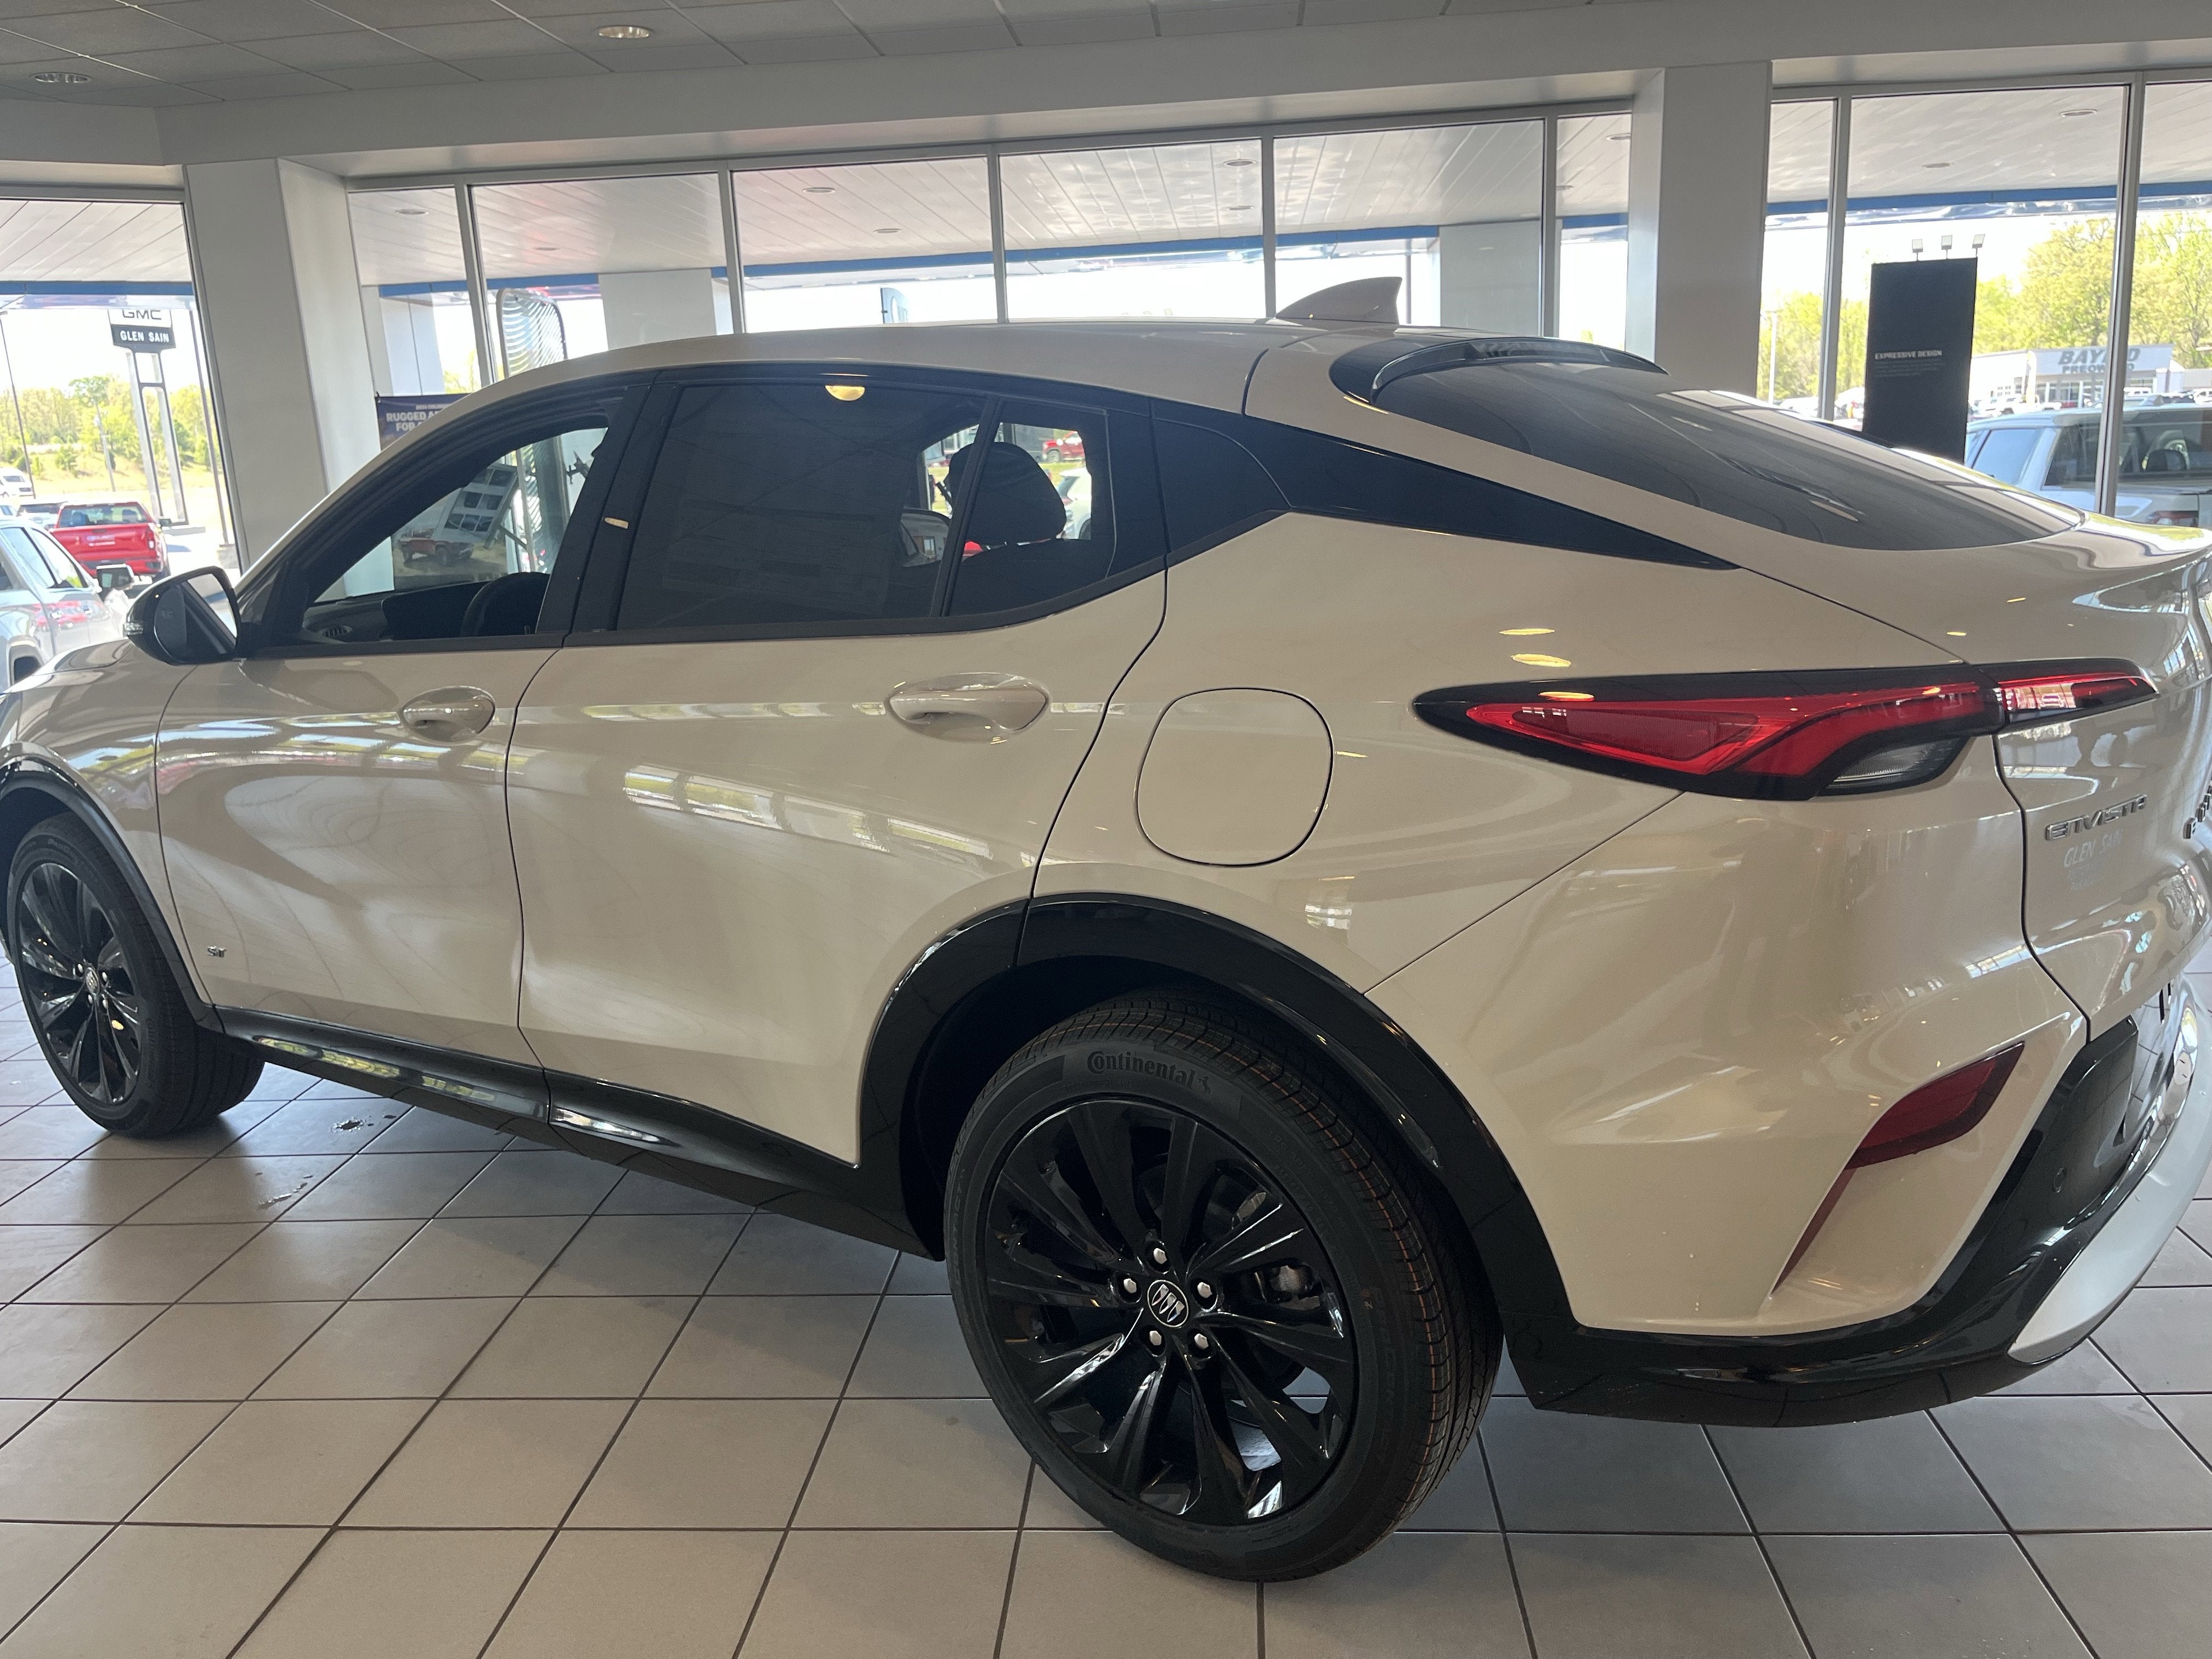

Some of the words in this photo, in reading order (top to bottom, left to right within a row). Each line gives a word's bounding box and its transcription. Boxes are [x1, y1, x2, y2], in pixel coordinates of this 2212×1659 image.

[122, 309, 162, 320] GMC
[120, 330, 145, 341] GLEN
[148, 331, 170, 343] SAIN
[1874, 352, 1916, 360] EXPRESSIVE
[1917, 349, 1943, 358] DESIGN
[2059, 347, 2141, 365] BAYD
[386, 411, 427, 422] RUGGED
[2064, 839, 2096, 868] GLEN
[1087, 1051, 1195, 1089] Continental
